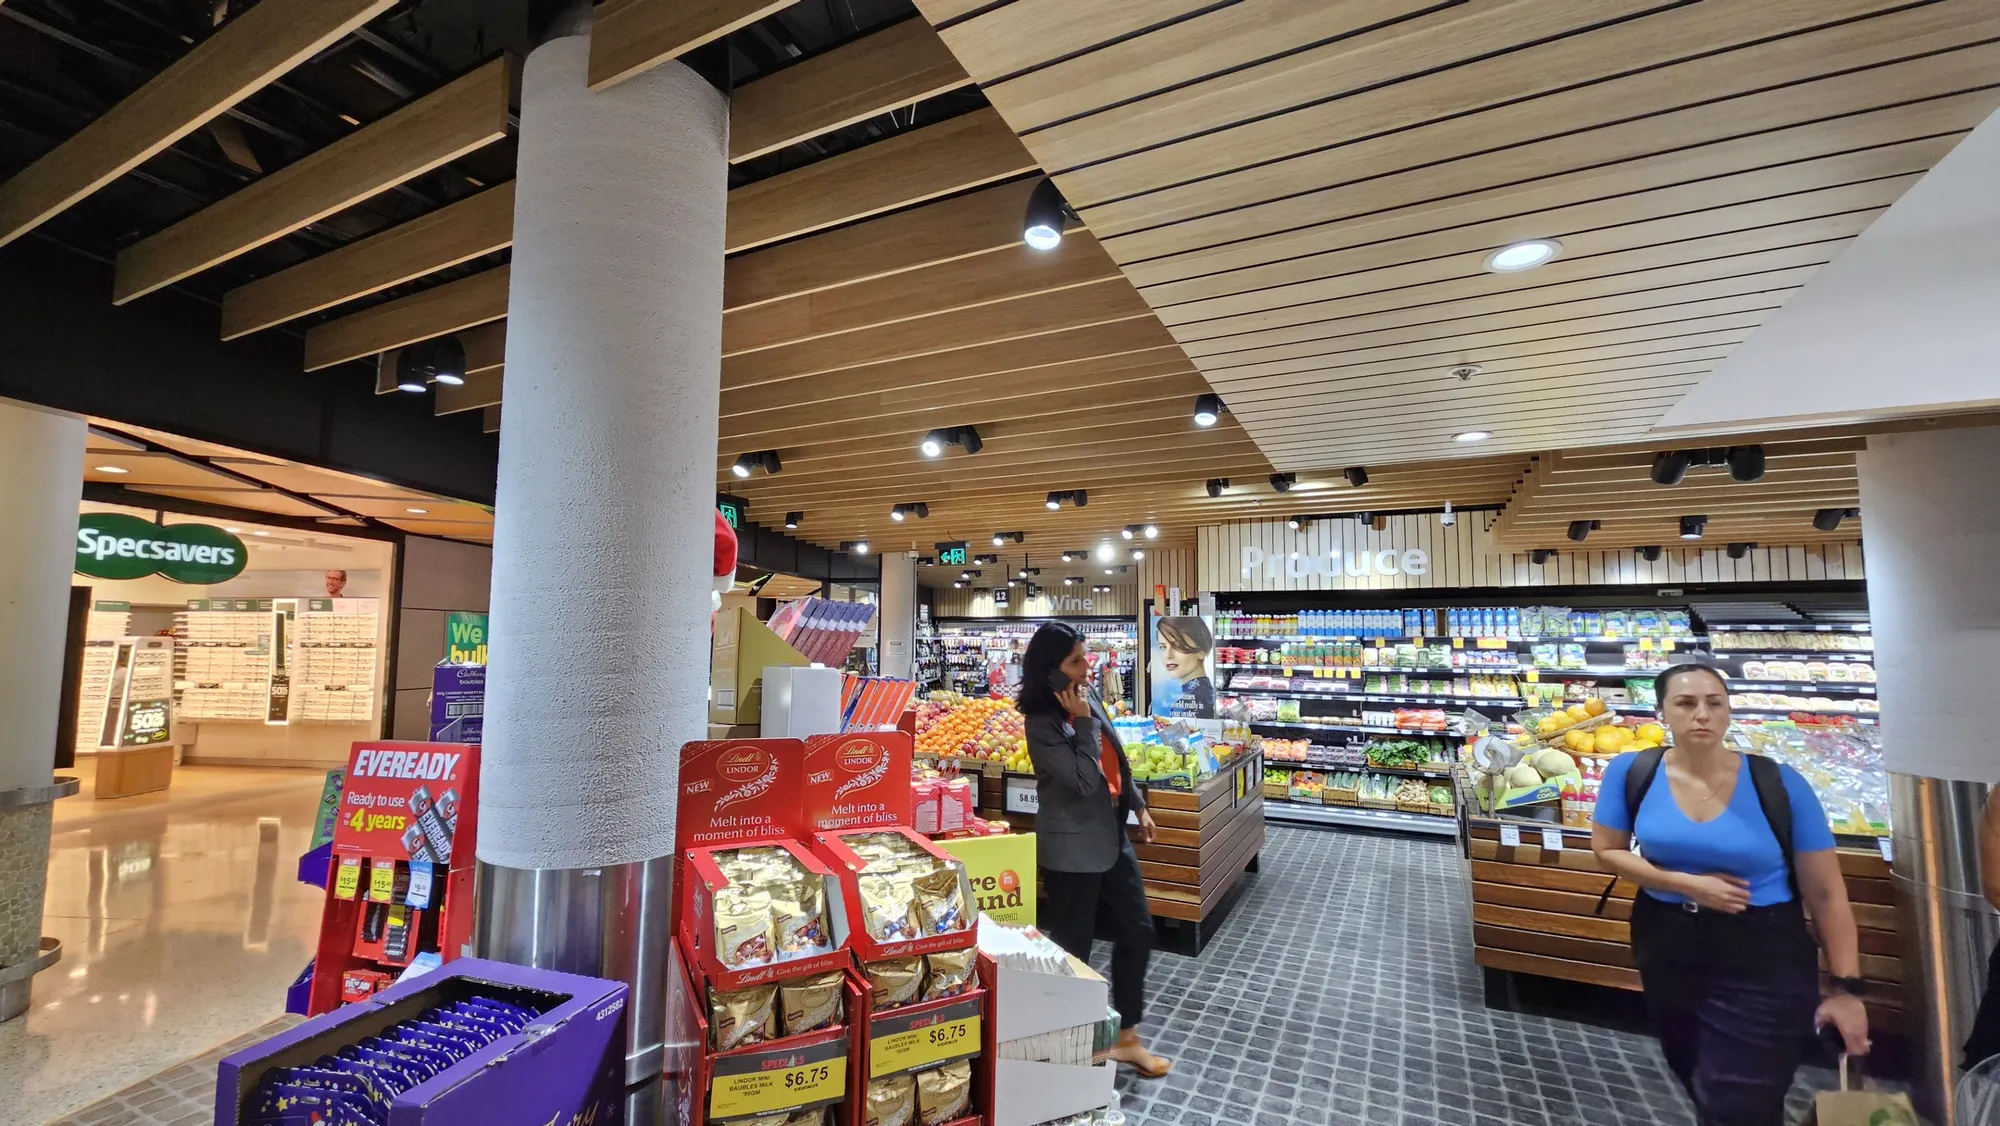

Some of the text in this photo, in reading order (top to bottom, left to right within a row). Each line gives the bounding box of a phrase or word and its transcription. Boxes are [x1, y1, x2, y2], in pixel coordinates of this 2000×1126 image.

[77, 528, 235, 566] Specsavers
[1241, 540, 1429, 579] Produce
[996, 592, 1006, 601] 12
[1045, 594, 1093, 611] Wine
[452, 622, 483, 644] We
[131, 711, 165, 731] 50%
[353, 750, 460, 780] EVEREADY
[844, 757, 873, 765] LINDOR
[726, 766, 759, 774] LINDOR
[810, 771, 831, 784] NEW
[686, 780, 710, 794] NEW
[347, 791, 405, 808] Ready to use
[831, 803, 885, 815] Melt into a
[350, 808, 365, 832] 4
[710, 815, 771, 828] Melt into a
[818, 811, 897, 828] moment of bliss
[693, 825, 785, 841] moment of bliss
[880, 944, 906, 957] Lindt
[915, 943, 928, 951] Give
[938, 941, 946, 949] gift
[735, 960, 834, 985] Lindt Give the gift of bliss
[595, 998, 624, 1021] 4312582
[929, 1024, 966, 1044] $6.75
[733, 1075, 770, 1085] LINDOR MINI
[785, 1066, 829, 1088] $6.75
[729, 1081, 774, 1092] BAUBLES MILK
